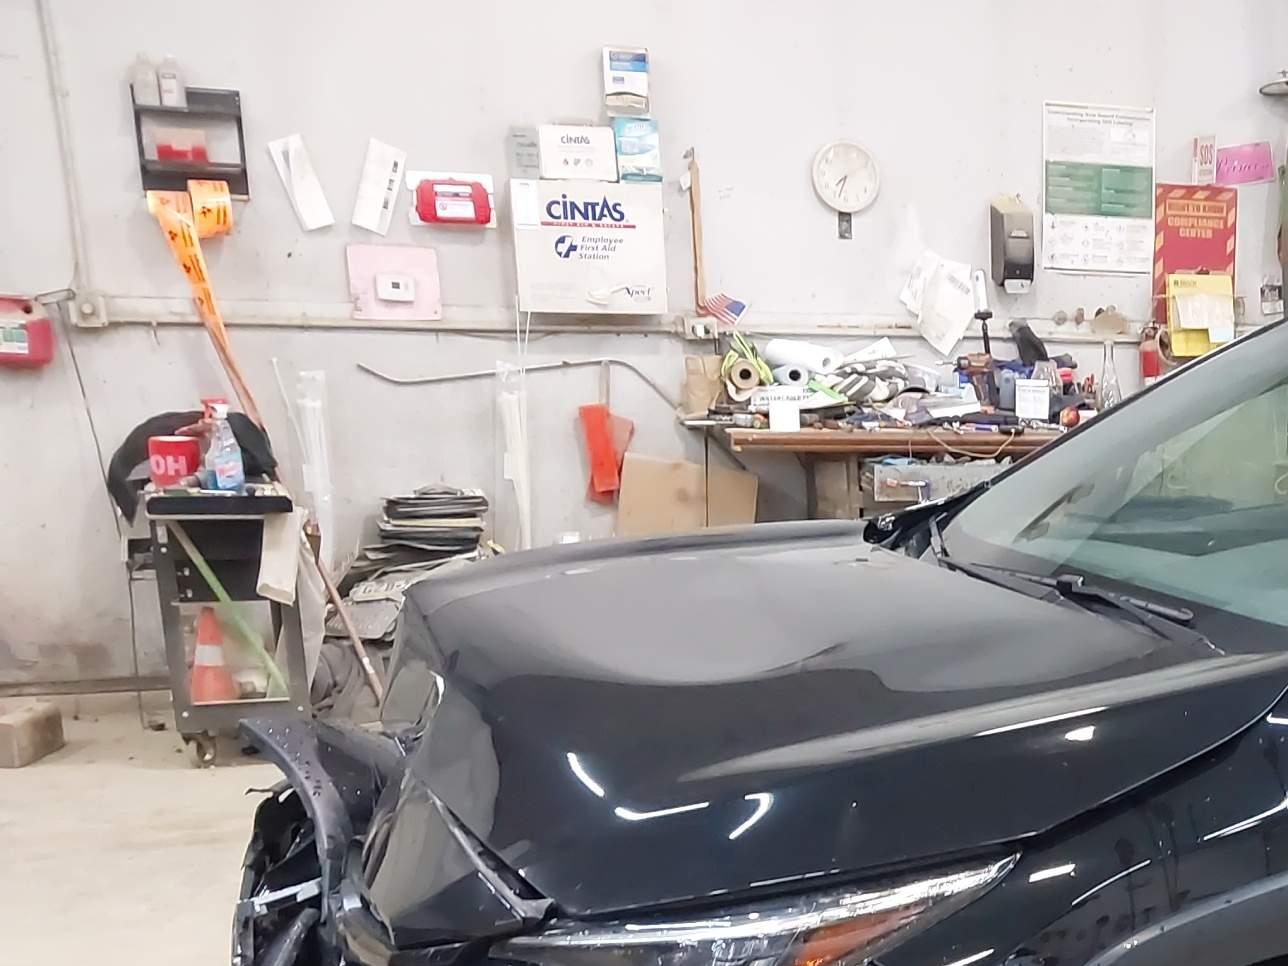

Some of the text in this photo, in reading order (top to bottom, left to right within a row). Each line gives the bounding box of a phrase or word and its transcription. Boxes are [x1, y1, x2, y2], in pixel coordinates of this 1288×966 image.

[1199, 143, 1213, 166] SOS
[581, 235, 624, 245] Employee
[580, 244, 616, 252] First Aid
[579, 253, 609, 261] Station
